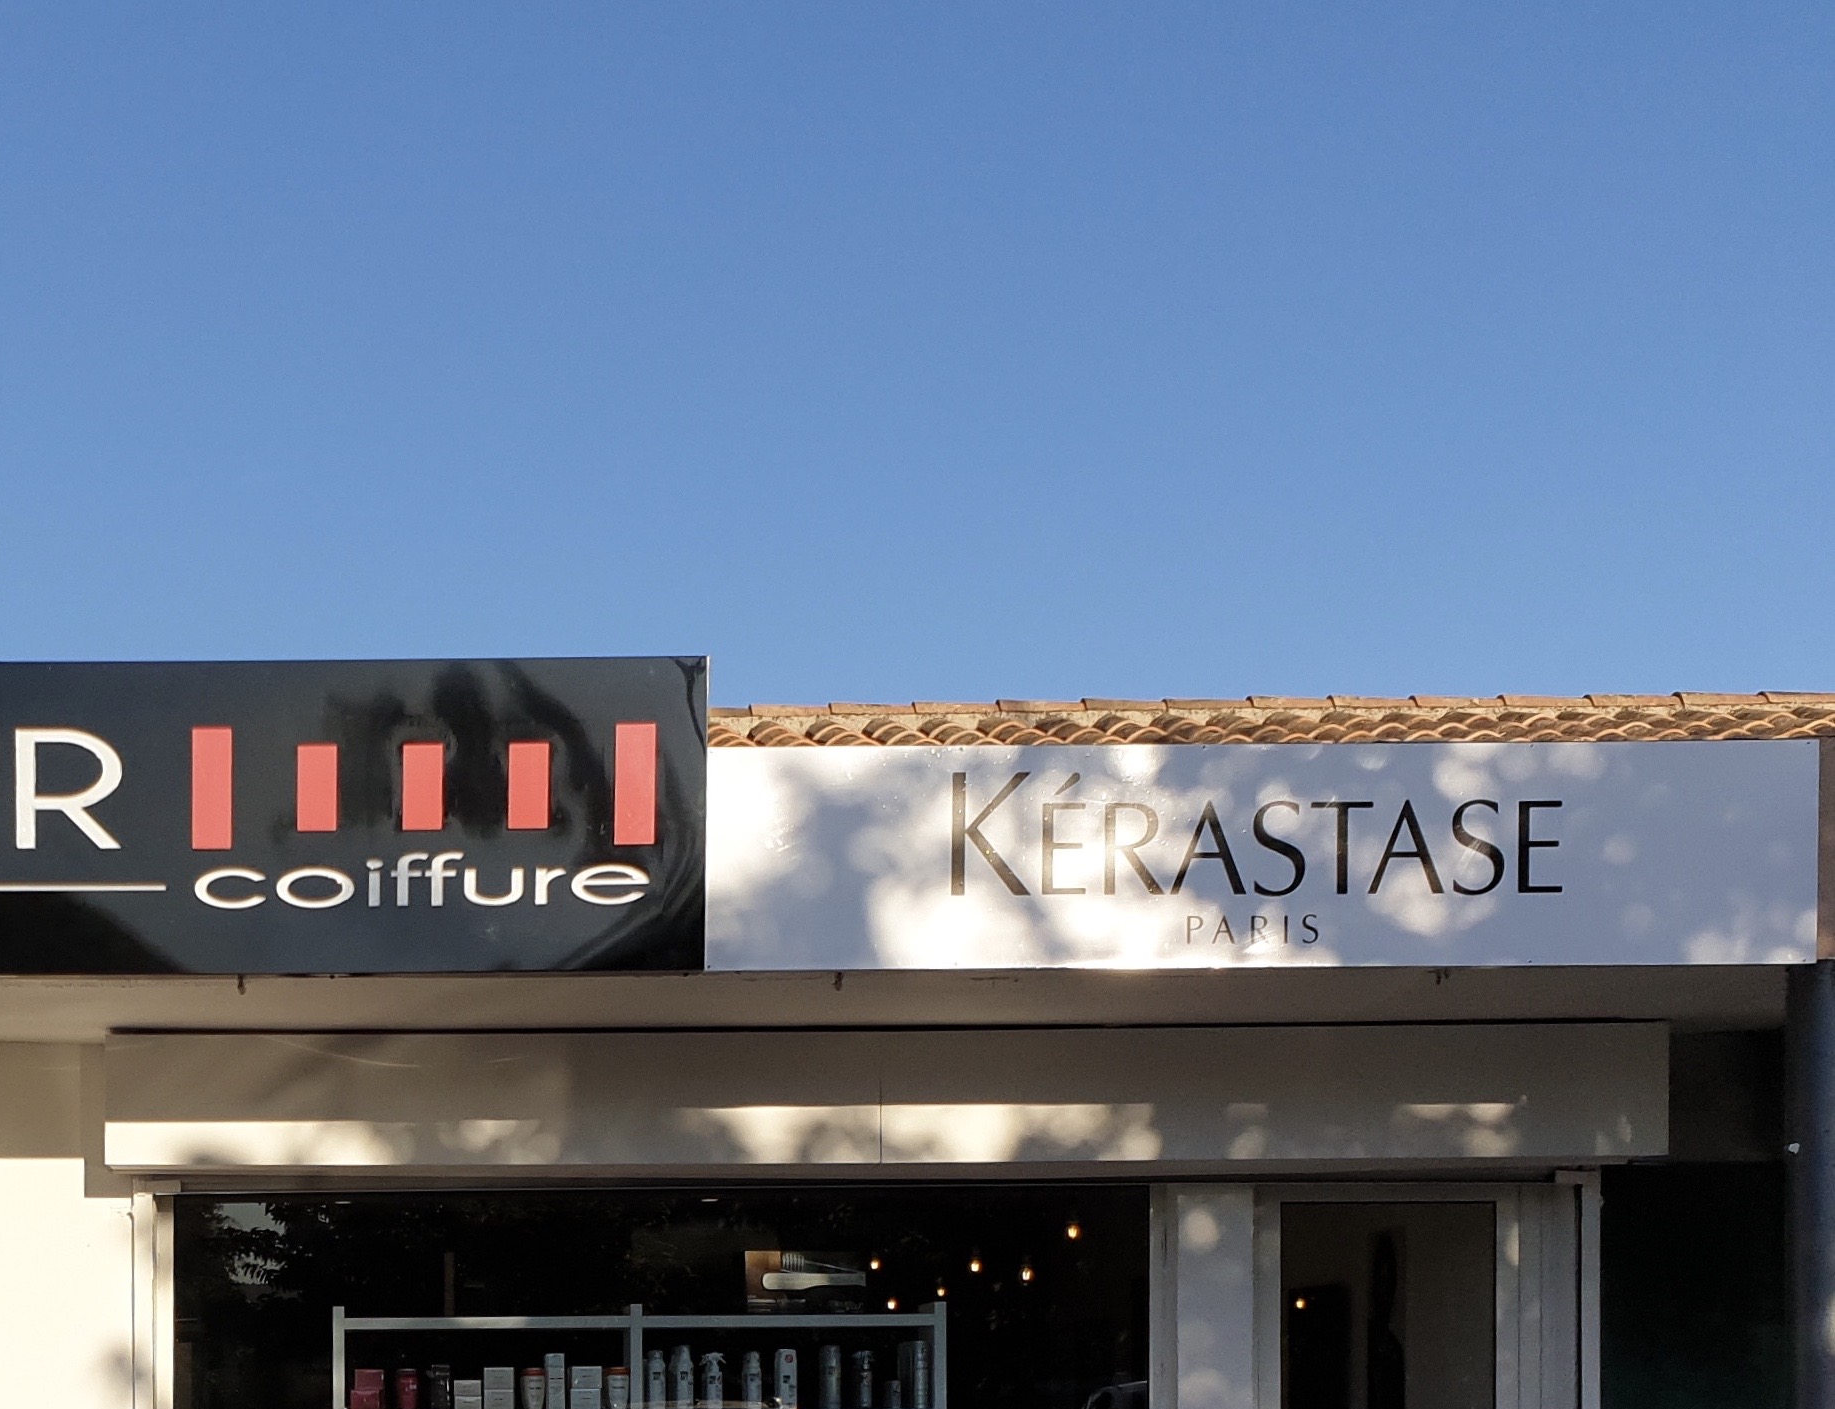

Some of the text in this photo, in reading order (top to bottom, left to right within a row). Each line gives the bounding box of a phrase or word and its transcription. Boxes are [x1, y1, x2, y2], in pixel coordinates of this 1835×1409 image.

[950, 772, 1564, 897] KÉRASTASE
[194, 852, 650, 910] coiffure
[1185, 913, 1320, 945] PARIS
